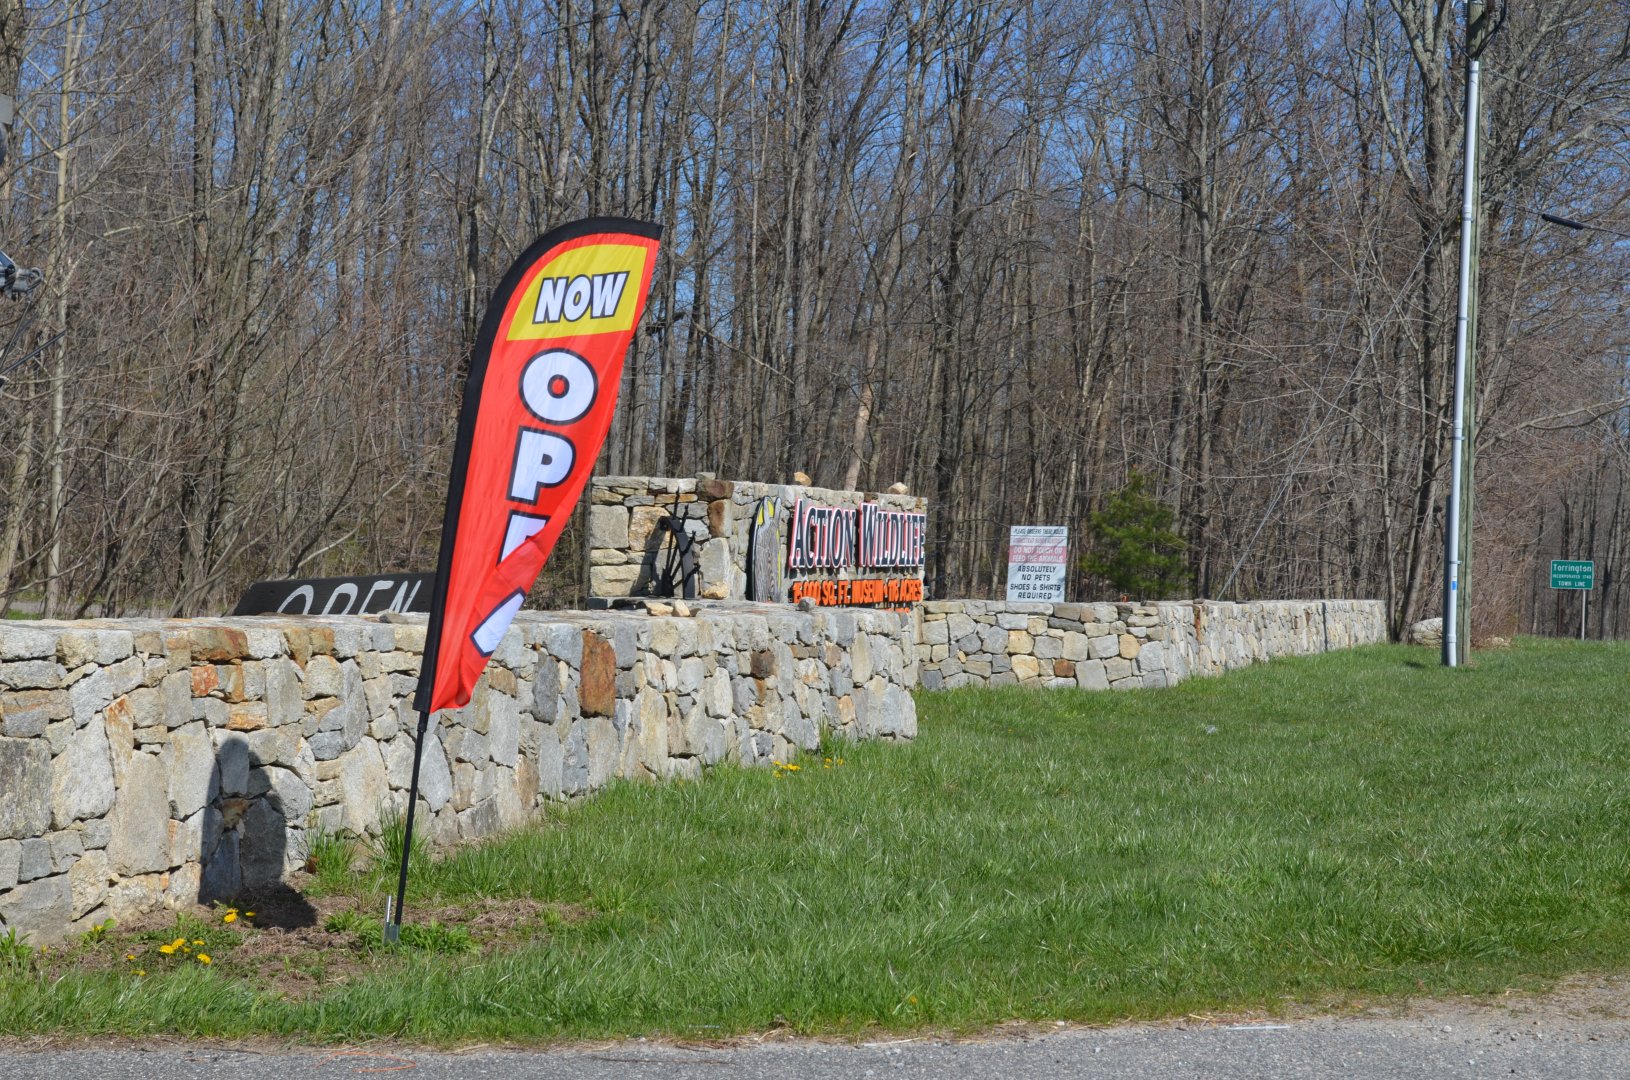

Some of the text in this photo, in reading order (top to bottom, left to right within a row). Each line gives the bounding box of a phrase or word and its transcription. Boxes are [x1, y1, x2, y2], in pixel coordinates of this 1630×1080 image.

[532, 271, 630, 324] NOW
[790, 497, 926, 568] ACTION WILDLIFE
[1017, 565, 1056, 573] ABSOLUTELY
[1552, 563, 1592, 574] Torrington
[793, 581, 820, 606] 15000
[852, 579, 884, 604] MUSEUM
[900, 579, 922, 602] ACRES
